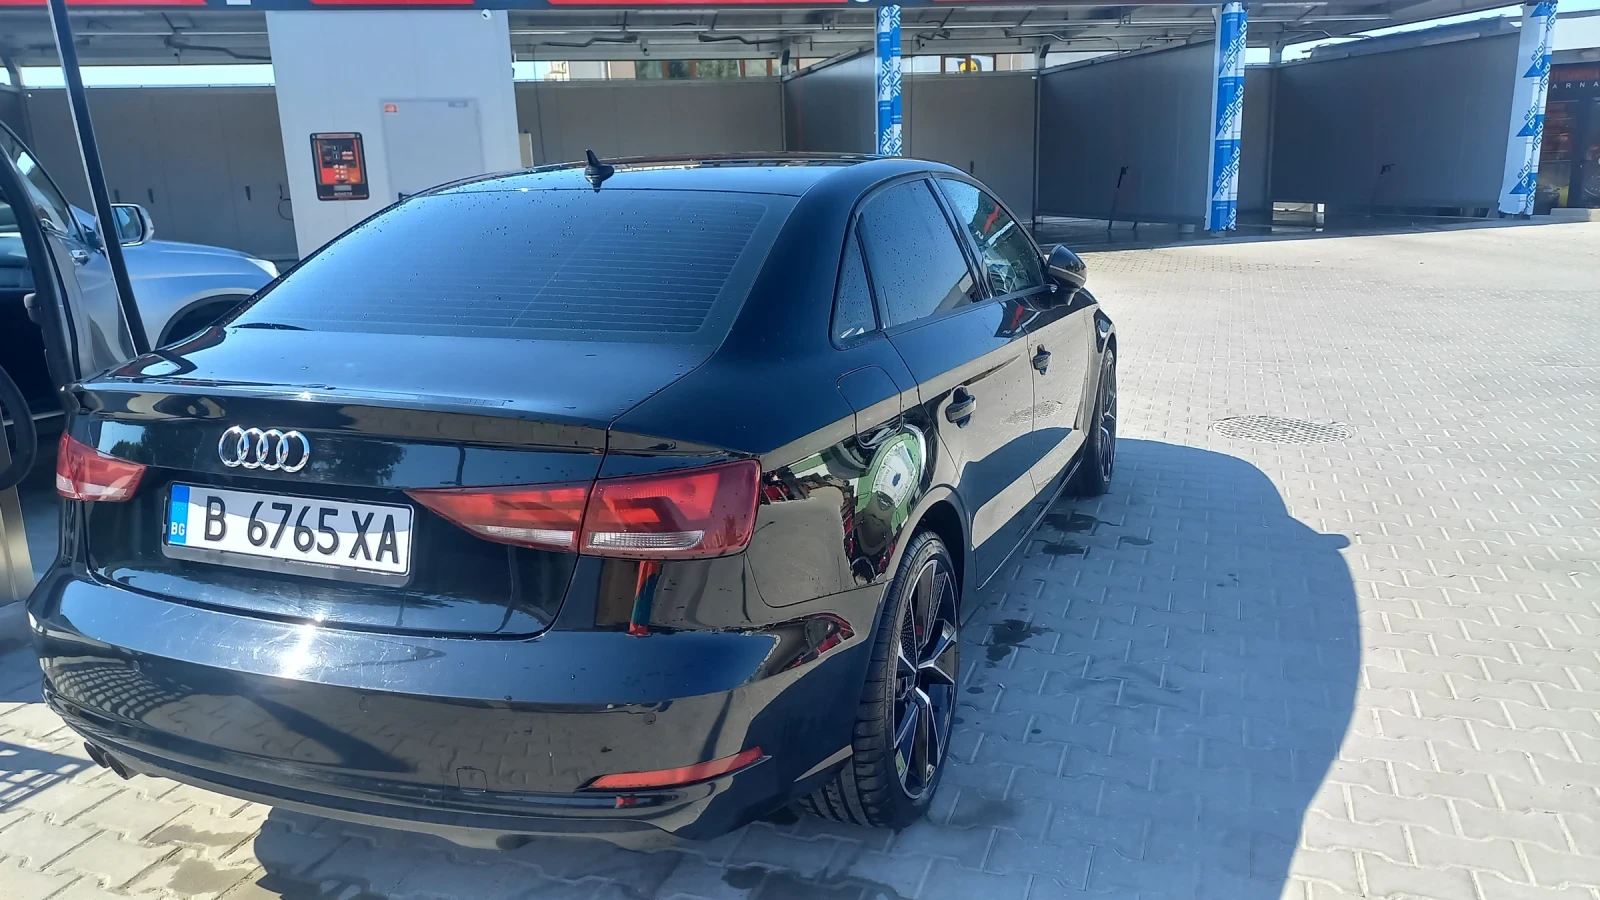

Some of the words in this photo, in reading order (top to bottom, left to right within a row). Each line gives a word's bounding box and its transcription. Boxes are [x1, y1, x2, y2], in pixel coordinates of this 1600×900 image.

[171, 521, 186, 536] BG
[204, 495, 227, 542] B
[247, 501, 340, 555] 6765
[348, 510, 400, 564] XA
